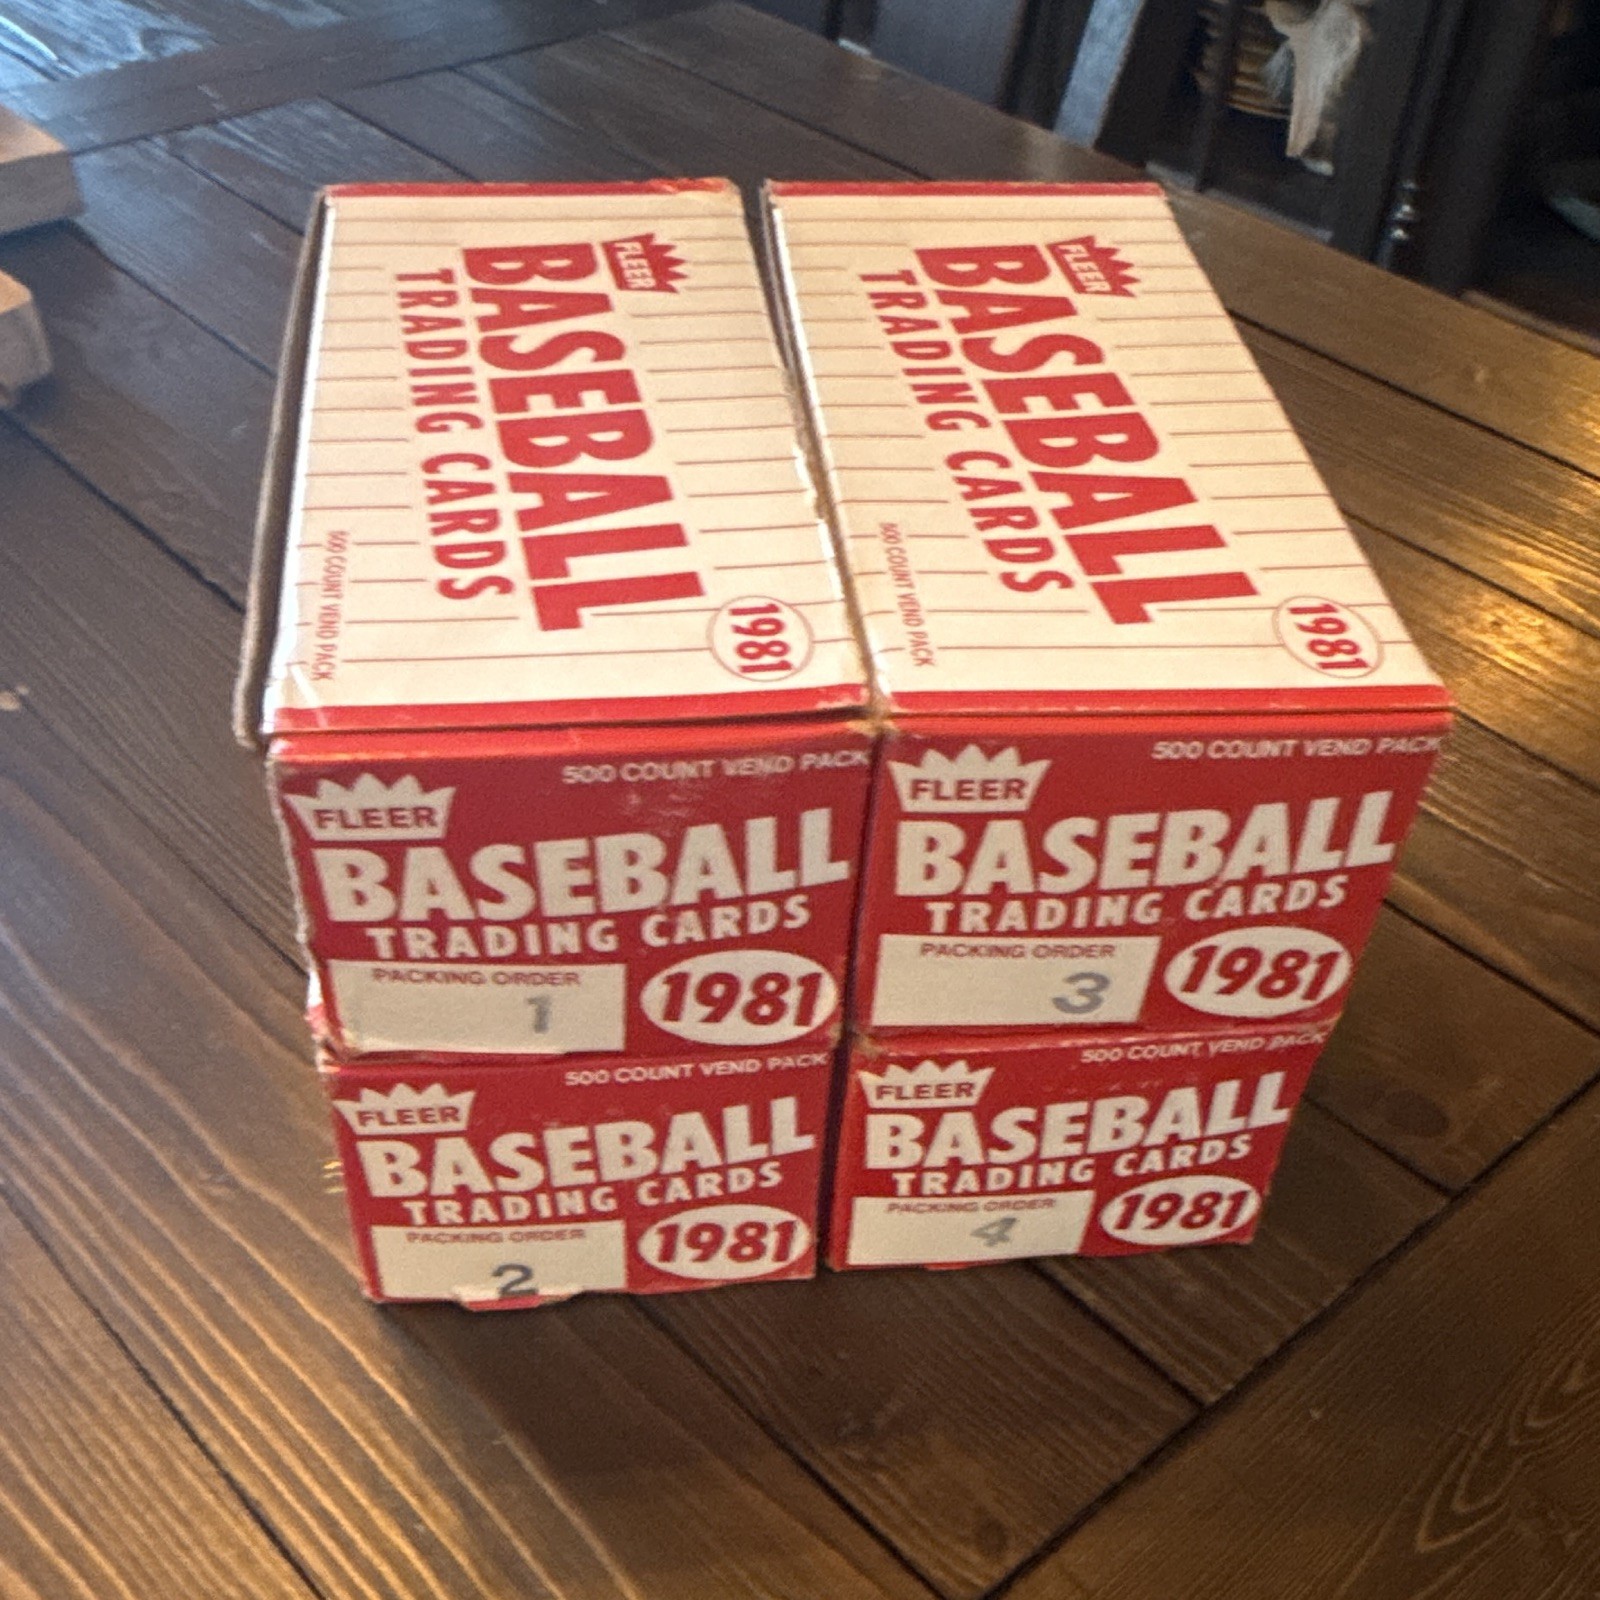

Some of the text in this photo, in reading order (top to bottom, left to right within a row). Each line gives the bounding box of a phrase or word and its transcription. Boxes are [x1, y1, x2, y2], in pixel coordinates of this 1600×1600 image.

[613, 241, 658, 289] FLEER
[1058, 244, 1112, 292] FLEER
[396, 268, 516, 601] TRADING CARDS
[463, 242, 705, 632] BASEBALL
[858, 270, 1073, 594] TRADING CARDS
[913, 244, 1261, 626] BASEBALL
[320, 555, 347, 599] COUNT
[884, 547, 915, 589] COUNT
[315, 603, 341, 639] VEND
[897, 593, 925, 627] VEND
[727, 603, 793, 675] 1981
[906, 631, 936, 667] PACK
[1286, 602, 1372, 671] 1981
[311, 643, 338, 681] PACK
[562, 750, 869, 784] 500 COUNT VEND PACK
[1151, 736, 1441, 760] 500 COUNT VEND PACK
[909, 777, 1026, 801] FLEER
[315, 806, 436, 830] FLEER
[895, 790, 1396, 896] BASEBALL
[311, 807, 850, 923] BASEBALL
[925, 874, 1349, 934] TRADING CARDS
[365, 895, 811, 959] TRADING CARDS
[920, 942, 1117, 960] PACKING ORDER
[1180, 944, 1344, 1001] 1981
[371, 967, 581, 986] PACKING ORDER
[1051, 971, 1111, 1015] 3
[526, 996, 552, 1034] 1
[659, 971, 824, 1027] 1981
[564, 1053, 829, 1086] 500 COUNT VEND PACK
[1080, 1032, 1328, 1064] 500 COUNT VEND PACK
[875, 1080, 975, 1101] FLEER
[356, 1105, 462, 1127] FLEER
[865, 1071, 1290, 1170] BASEBALL
[355, 1096, 816, 1198] BASEBALL
[892, 1133, 1253, 1197] TRADING CARDS
[401, 1161, 783, 1226] TRADING CARDS
[887, 1199, 1056, 1215] PACKING ORDER
[1115, 1189, 1250, 1232] 1981
[406, 1229, 586, 1244] PACKING ORDER
[652, 1220, 798, 1264] 1981
[970, 1217, 1018, 1247] 4
[491, 1263, 538, 1296] 2
